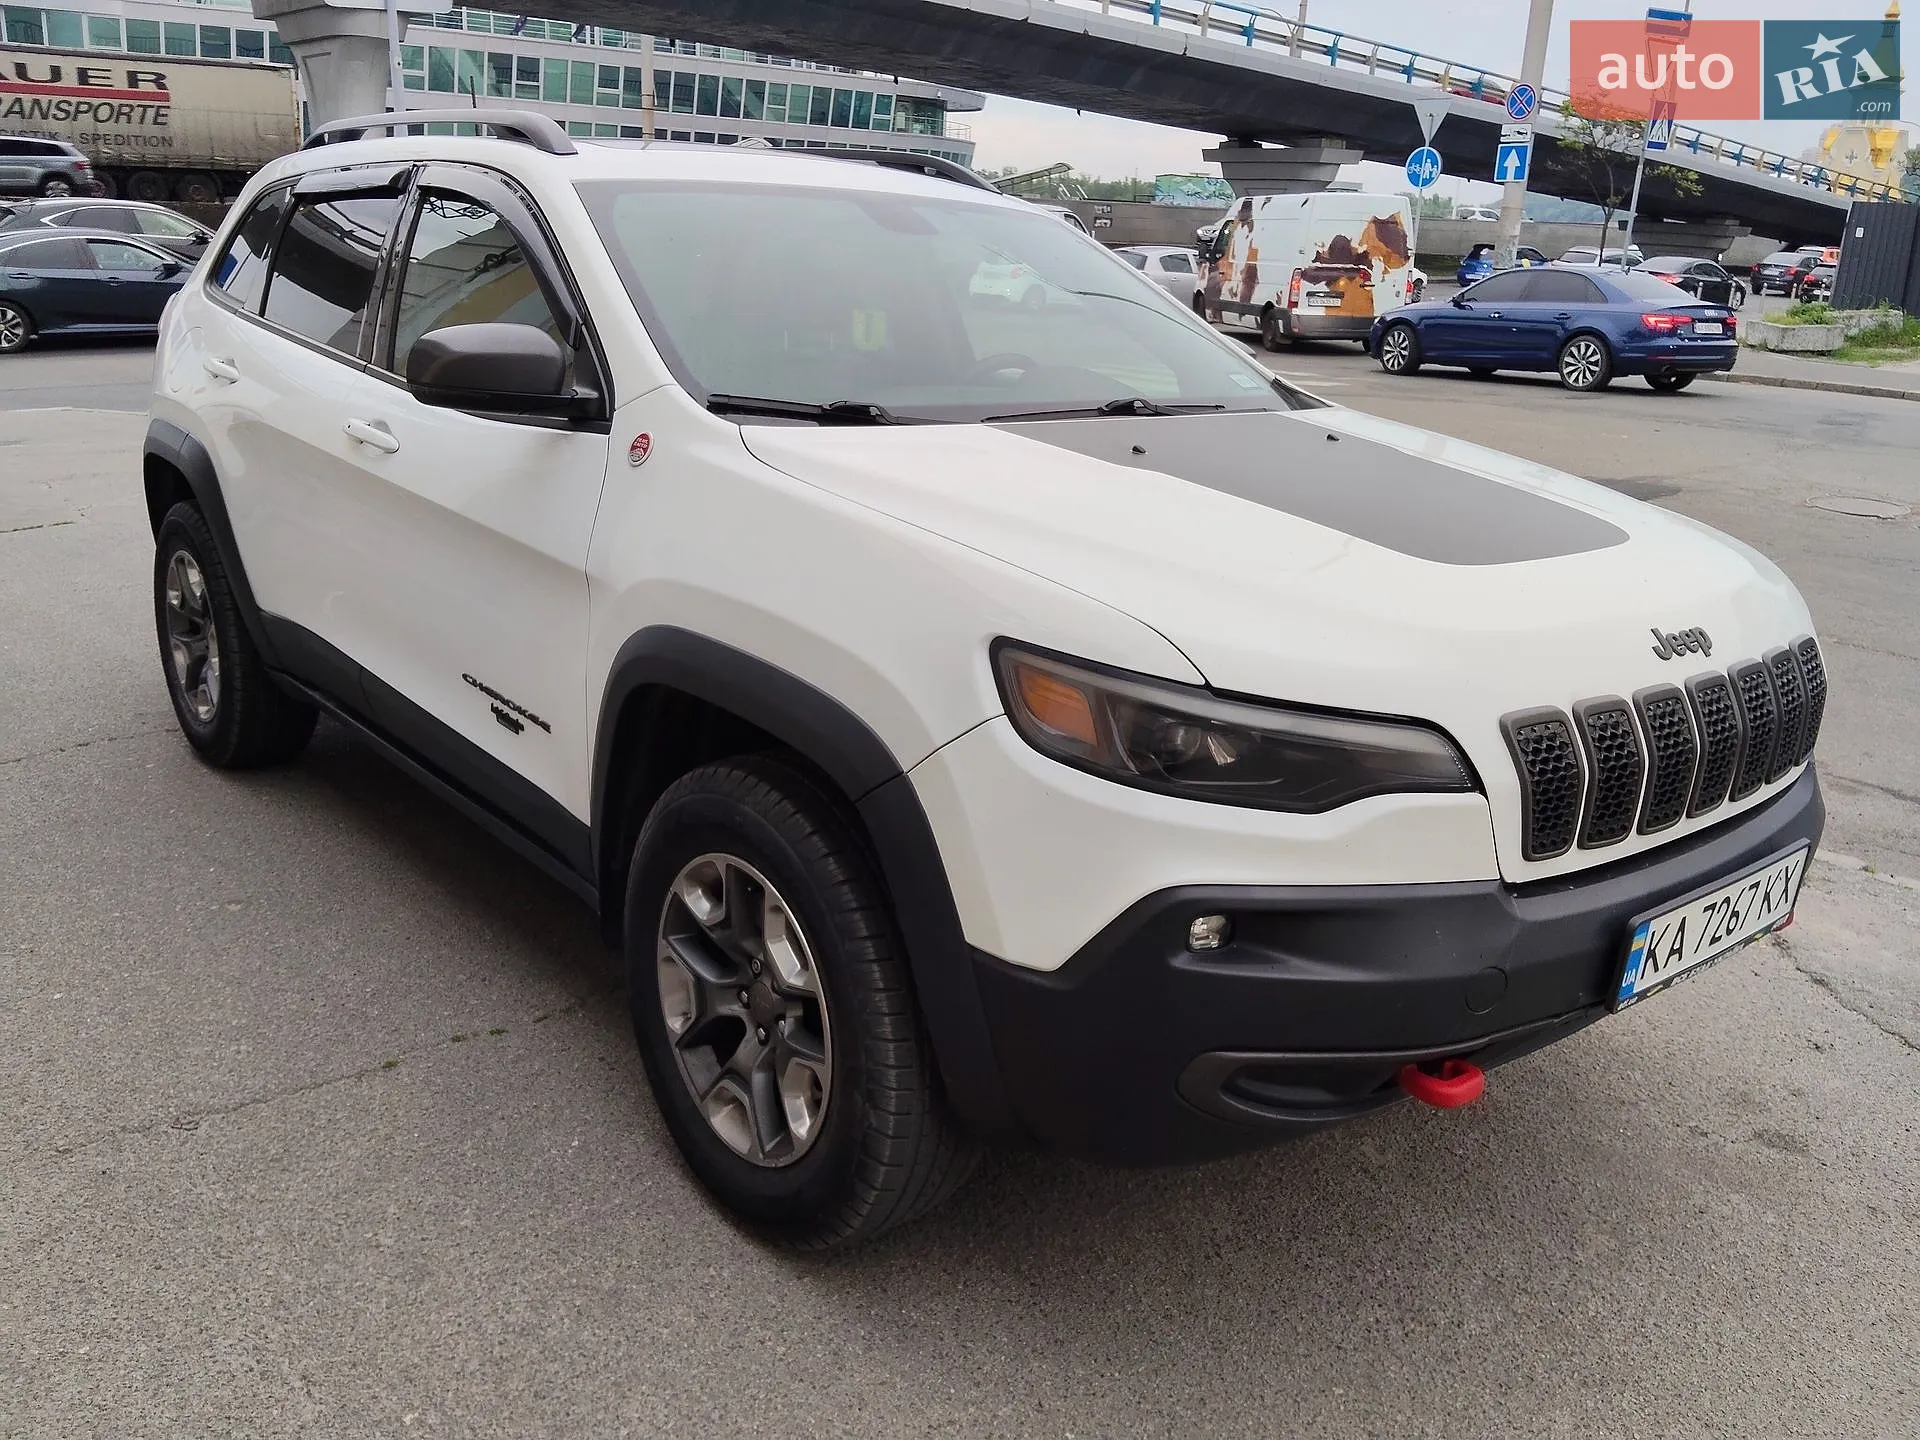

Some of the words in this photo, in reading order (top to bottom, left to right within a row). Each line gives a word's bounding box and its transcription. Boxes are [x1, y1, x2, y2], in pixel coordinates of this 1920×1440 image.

[0, 97, 170, 126] ANSPORTE
[79, 132, 173, 148] SPEDITION
[1650, 627, 1712, 661] Jeep
[1640, 916, 1687, 980] KA
[1694, 879, 1762, 954] 7267
[1757, 859, 1800, 921] KX
[1622, 968, 1637, 988] UA
